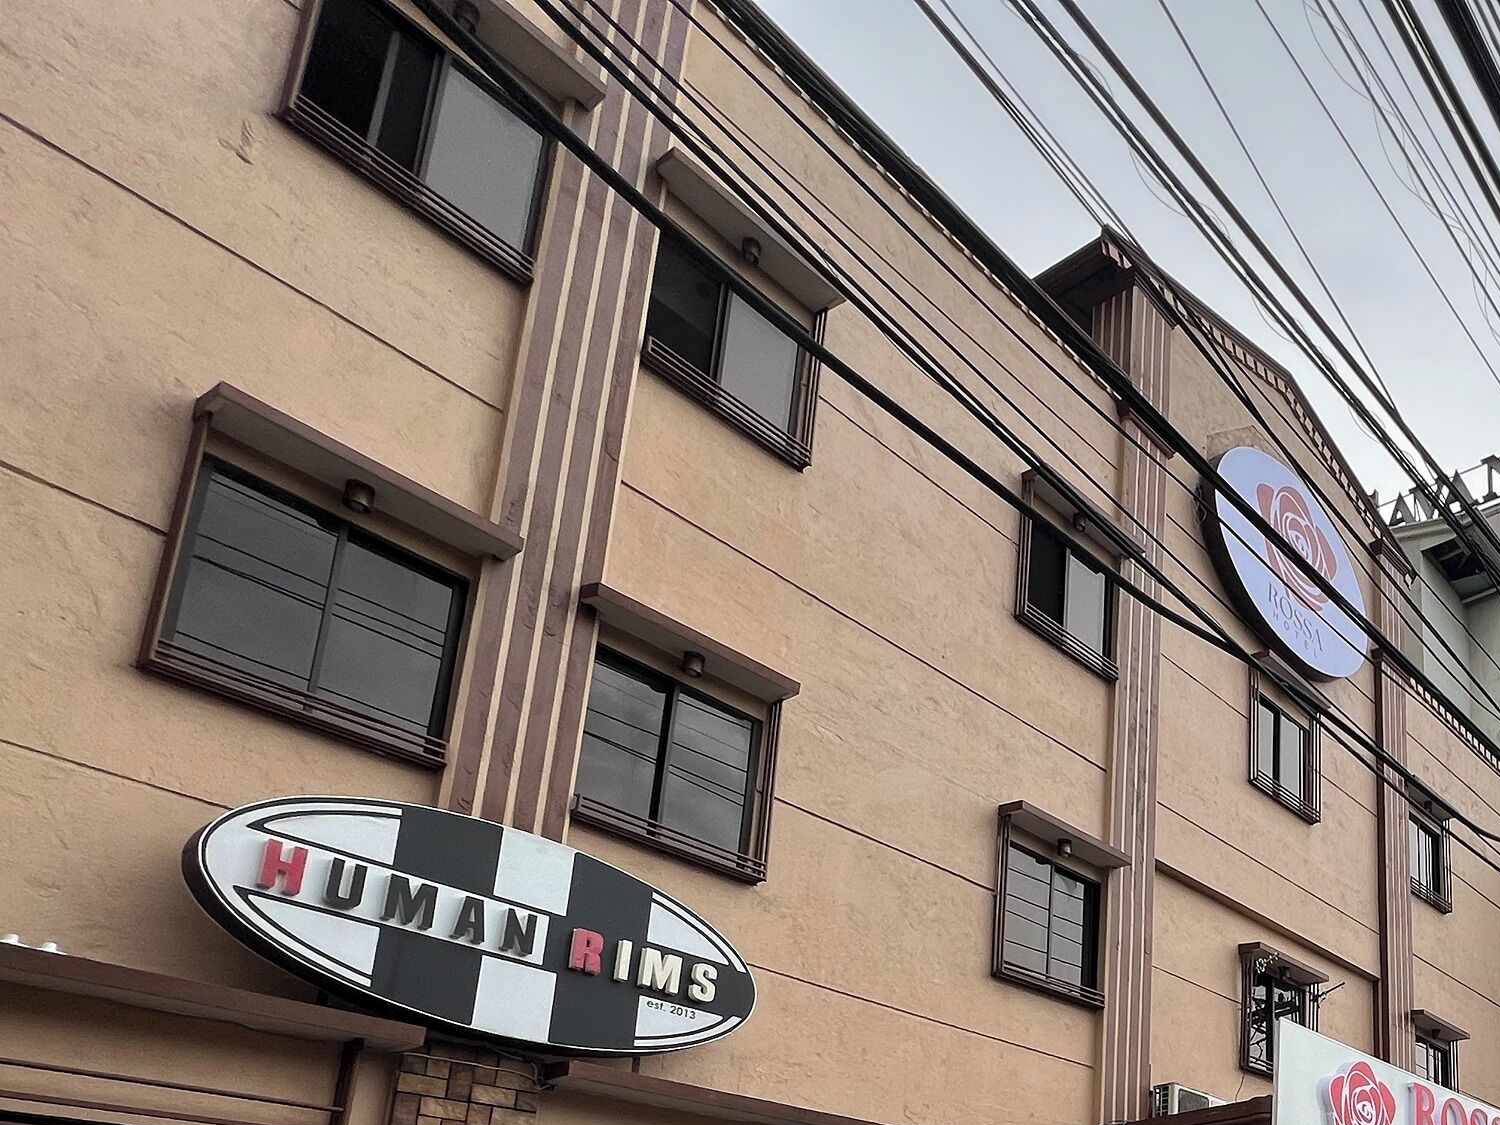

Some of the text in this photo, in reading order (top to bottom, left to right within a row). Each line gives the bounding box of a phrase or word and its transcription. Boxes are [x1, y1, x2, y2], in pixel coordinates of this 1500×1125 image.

[1268, 582, 1323, 653] ROSSA
[256, 838, 718, 1003] HUMAN RIMS
[646, 1000, 697, 1020] est. 2013
